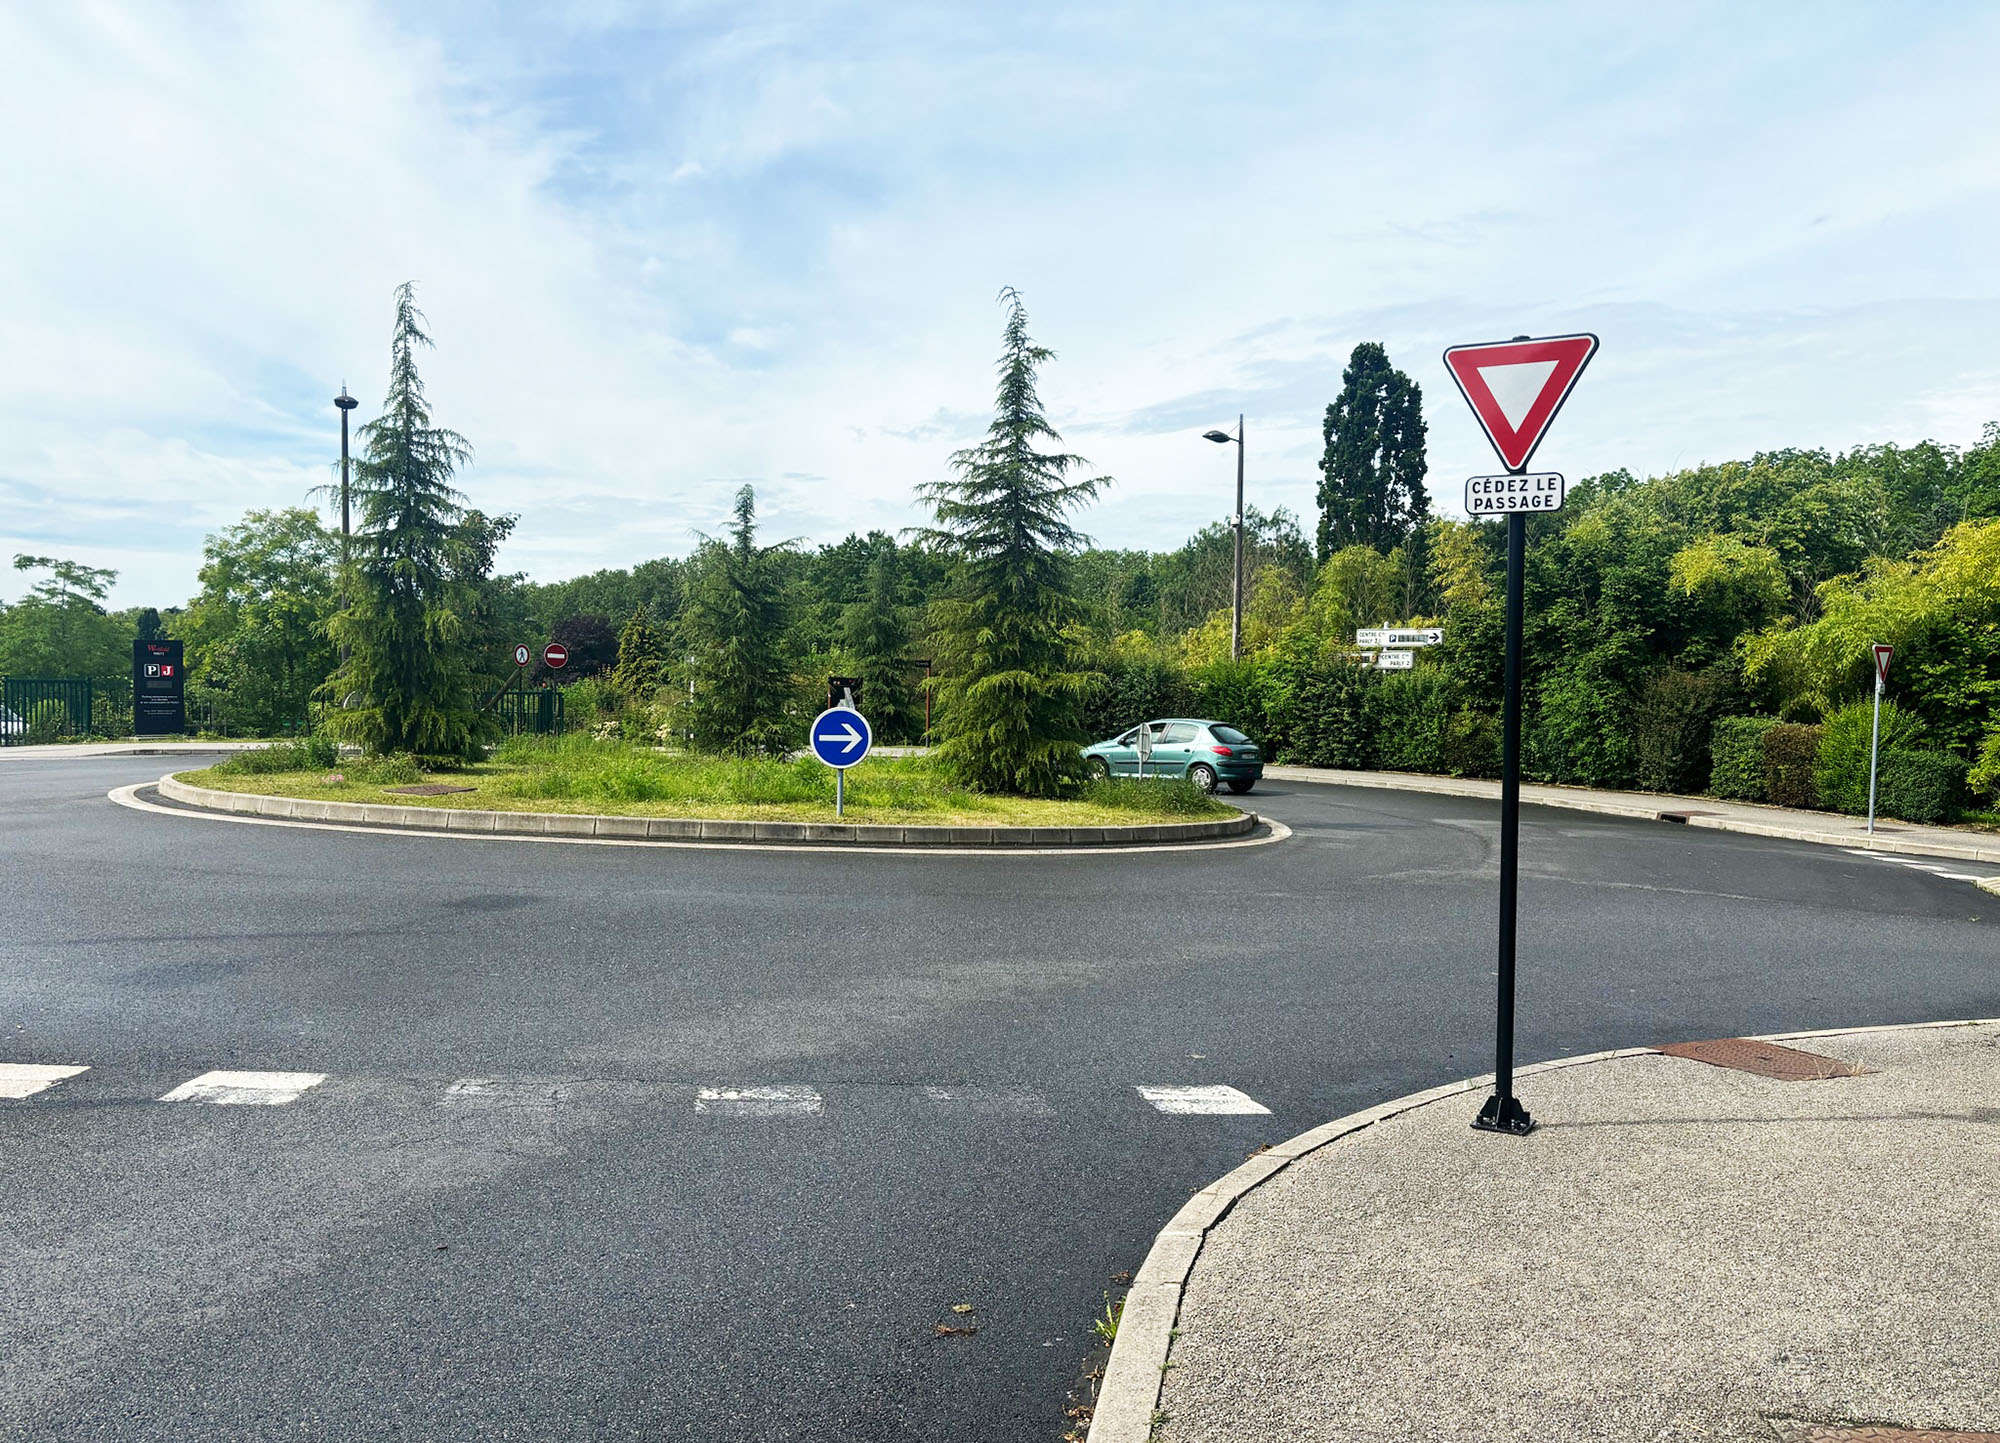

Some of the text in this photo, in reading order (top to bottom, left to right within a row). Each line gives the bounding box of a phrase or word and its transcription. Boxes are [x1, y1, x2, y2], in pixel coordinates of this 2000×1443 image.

[1472, 477, 1557, 494] CÉDEZ LE
[1474, 495, 1554, 510] PASSAGE
[147, 665, 172, 676] P J
